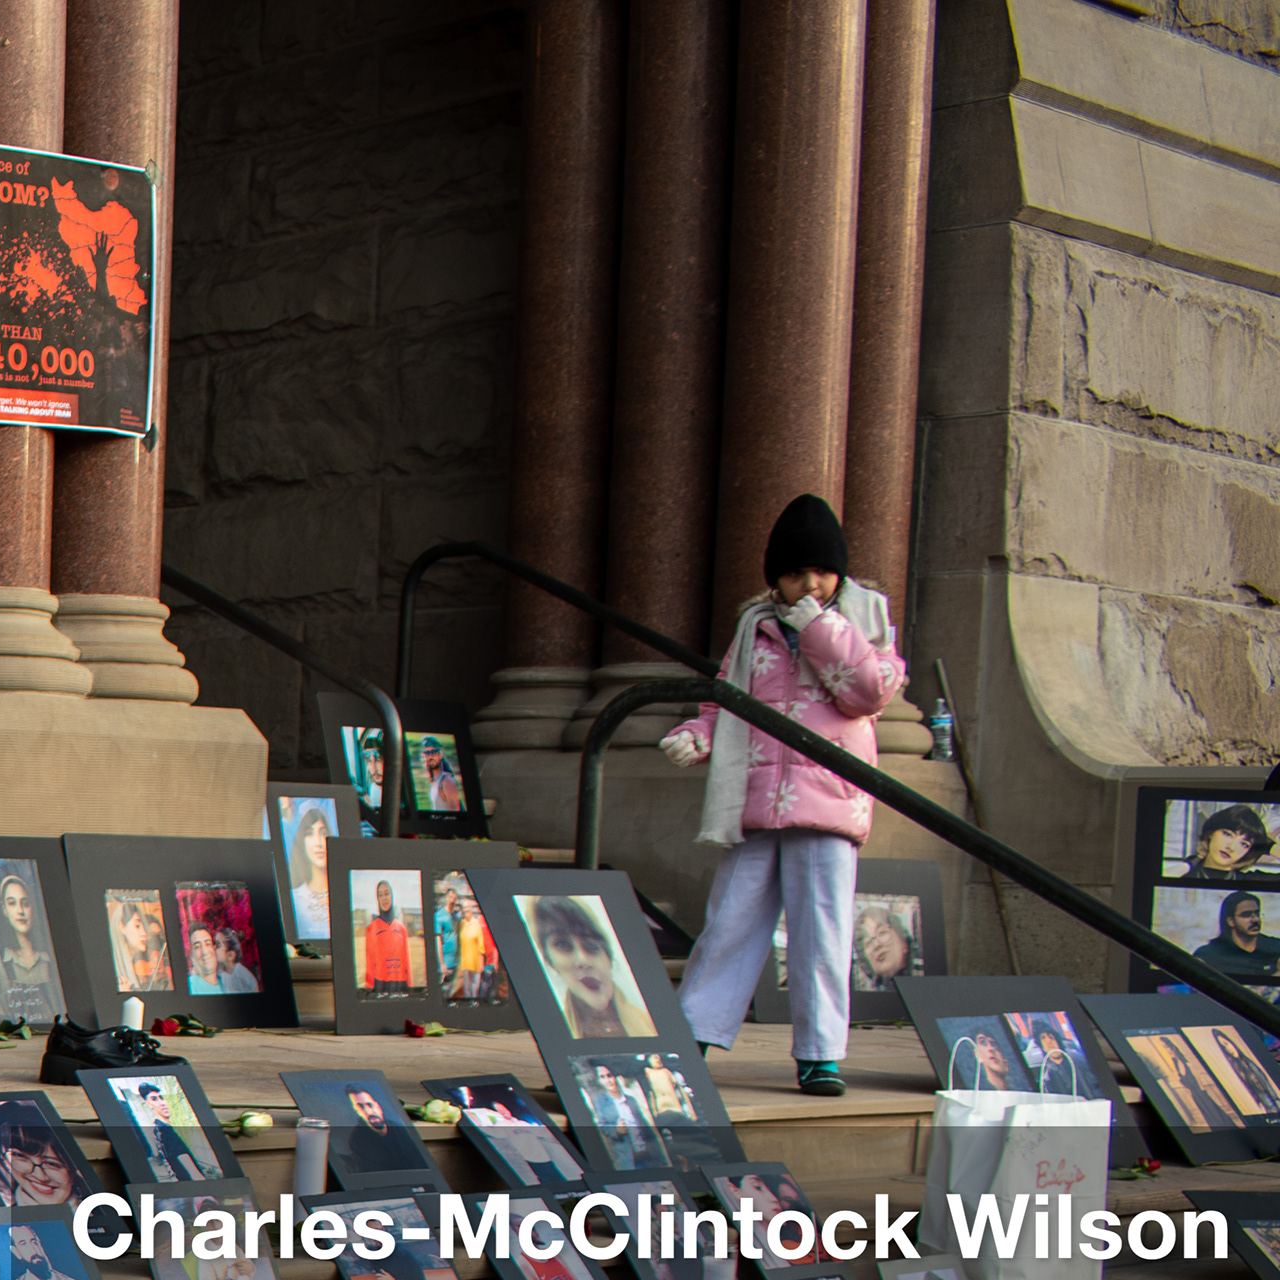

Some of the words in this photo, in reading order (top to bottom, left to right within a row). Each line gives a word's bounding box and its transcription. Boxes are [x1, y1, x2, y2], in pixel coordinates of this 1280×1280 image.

[15, 161, 30, 176] of
[1, 323, 43, 341] THAN
[5, 372, 13, 382] is
[14, 373, 30, 382] not
[38, 374, 56, 386] just
[65, 376, 95, 388] number
[0, 403, 28, 414] TALKING
[29, 406, 54, 416] ABOUT
[55, 409, 71, 418] IRAN
[15, 397, 29, 405] We
[29, 398, 46, 407] won't
[48, 401, 71, 411] ignore.
